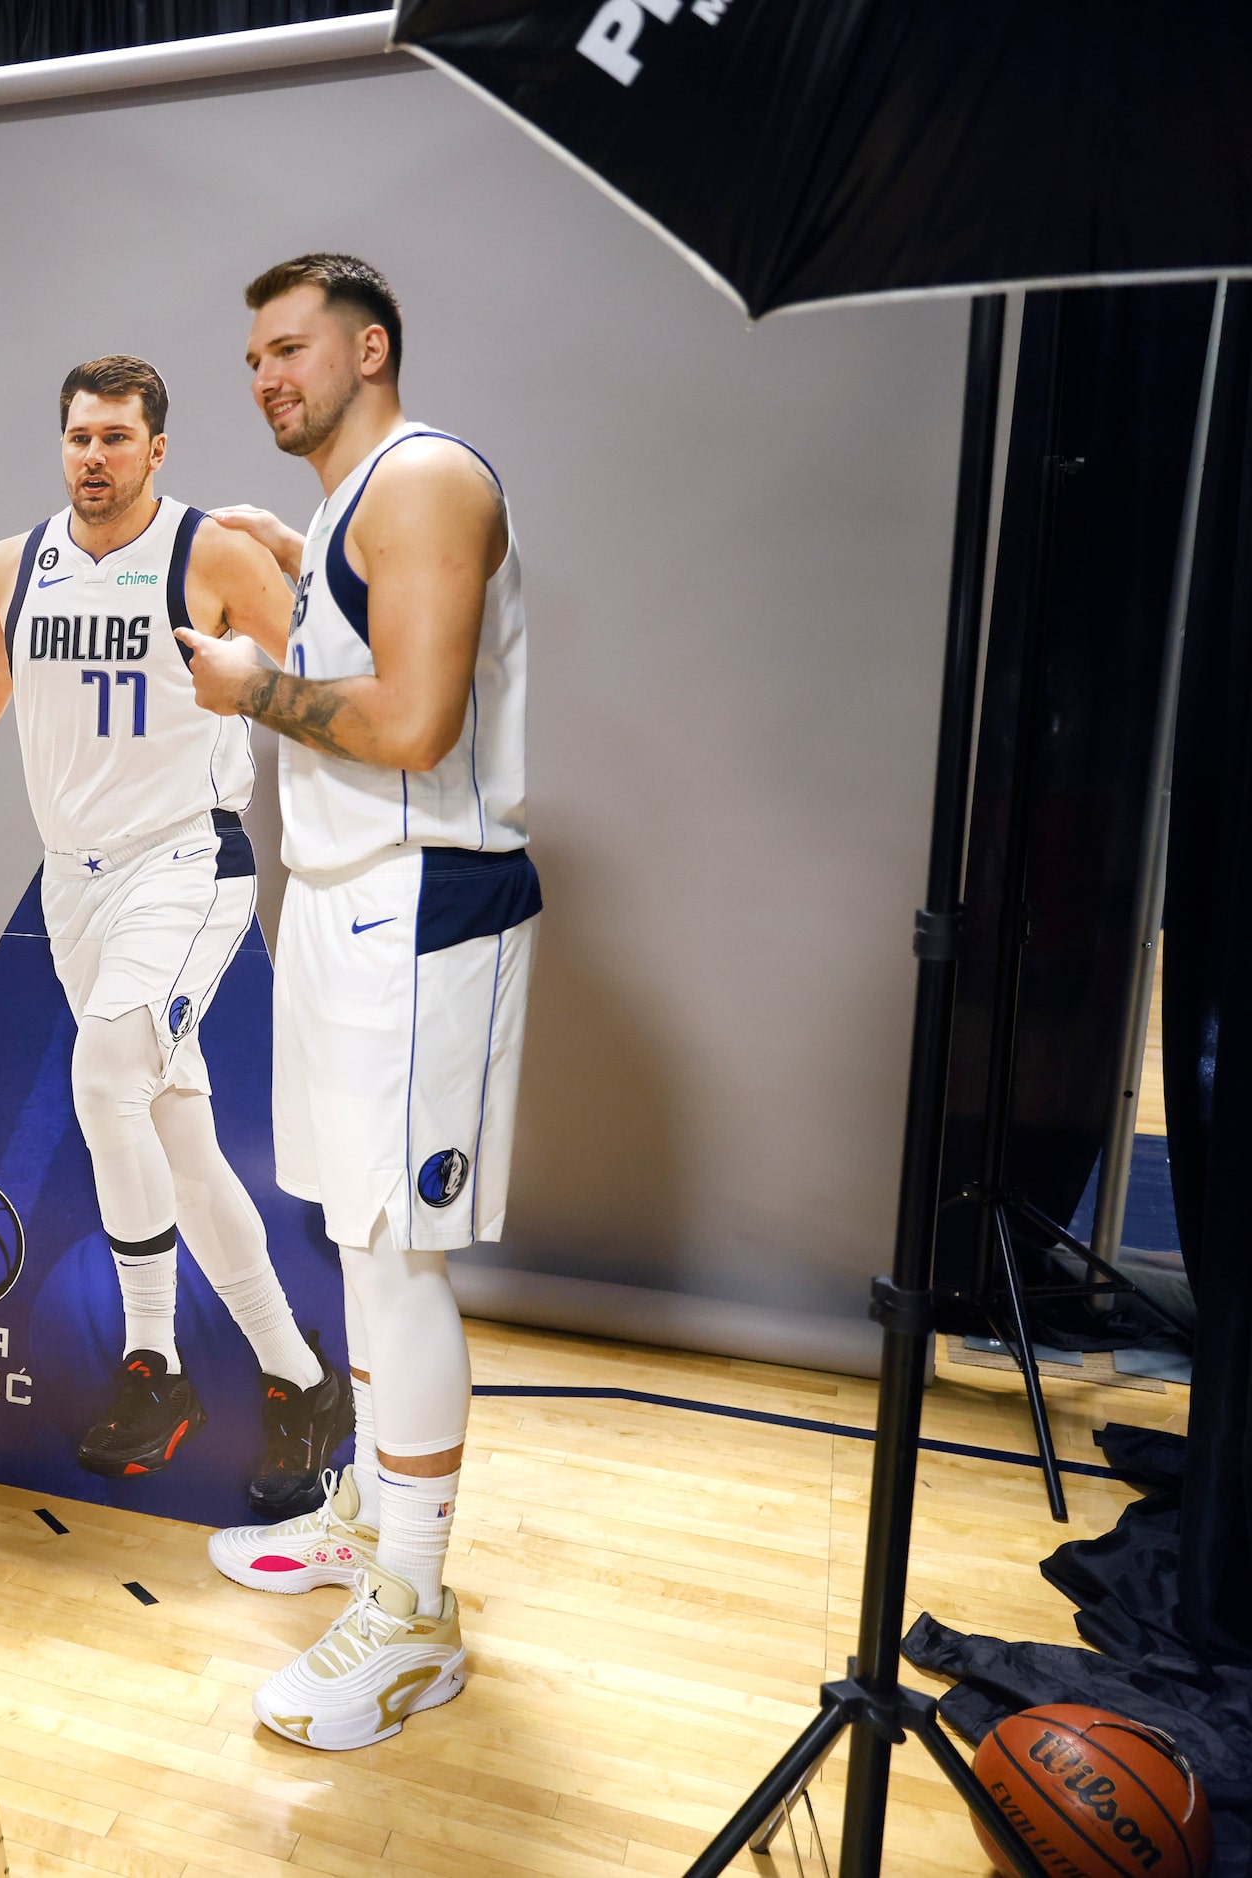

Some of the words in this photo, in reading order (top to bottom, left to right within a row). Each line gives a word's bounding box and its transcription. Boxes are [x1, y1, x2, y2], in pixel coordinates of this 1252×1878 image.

[116, 571, 158, 585] chime
[29, 615, 151, 661] DALLAS
[81, 669, 147, 737] 77
[1029, 1731, 1162, 1870] Wilson
